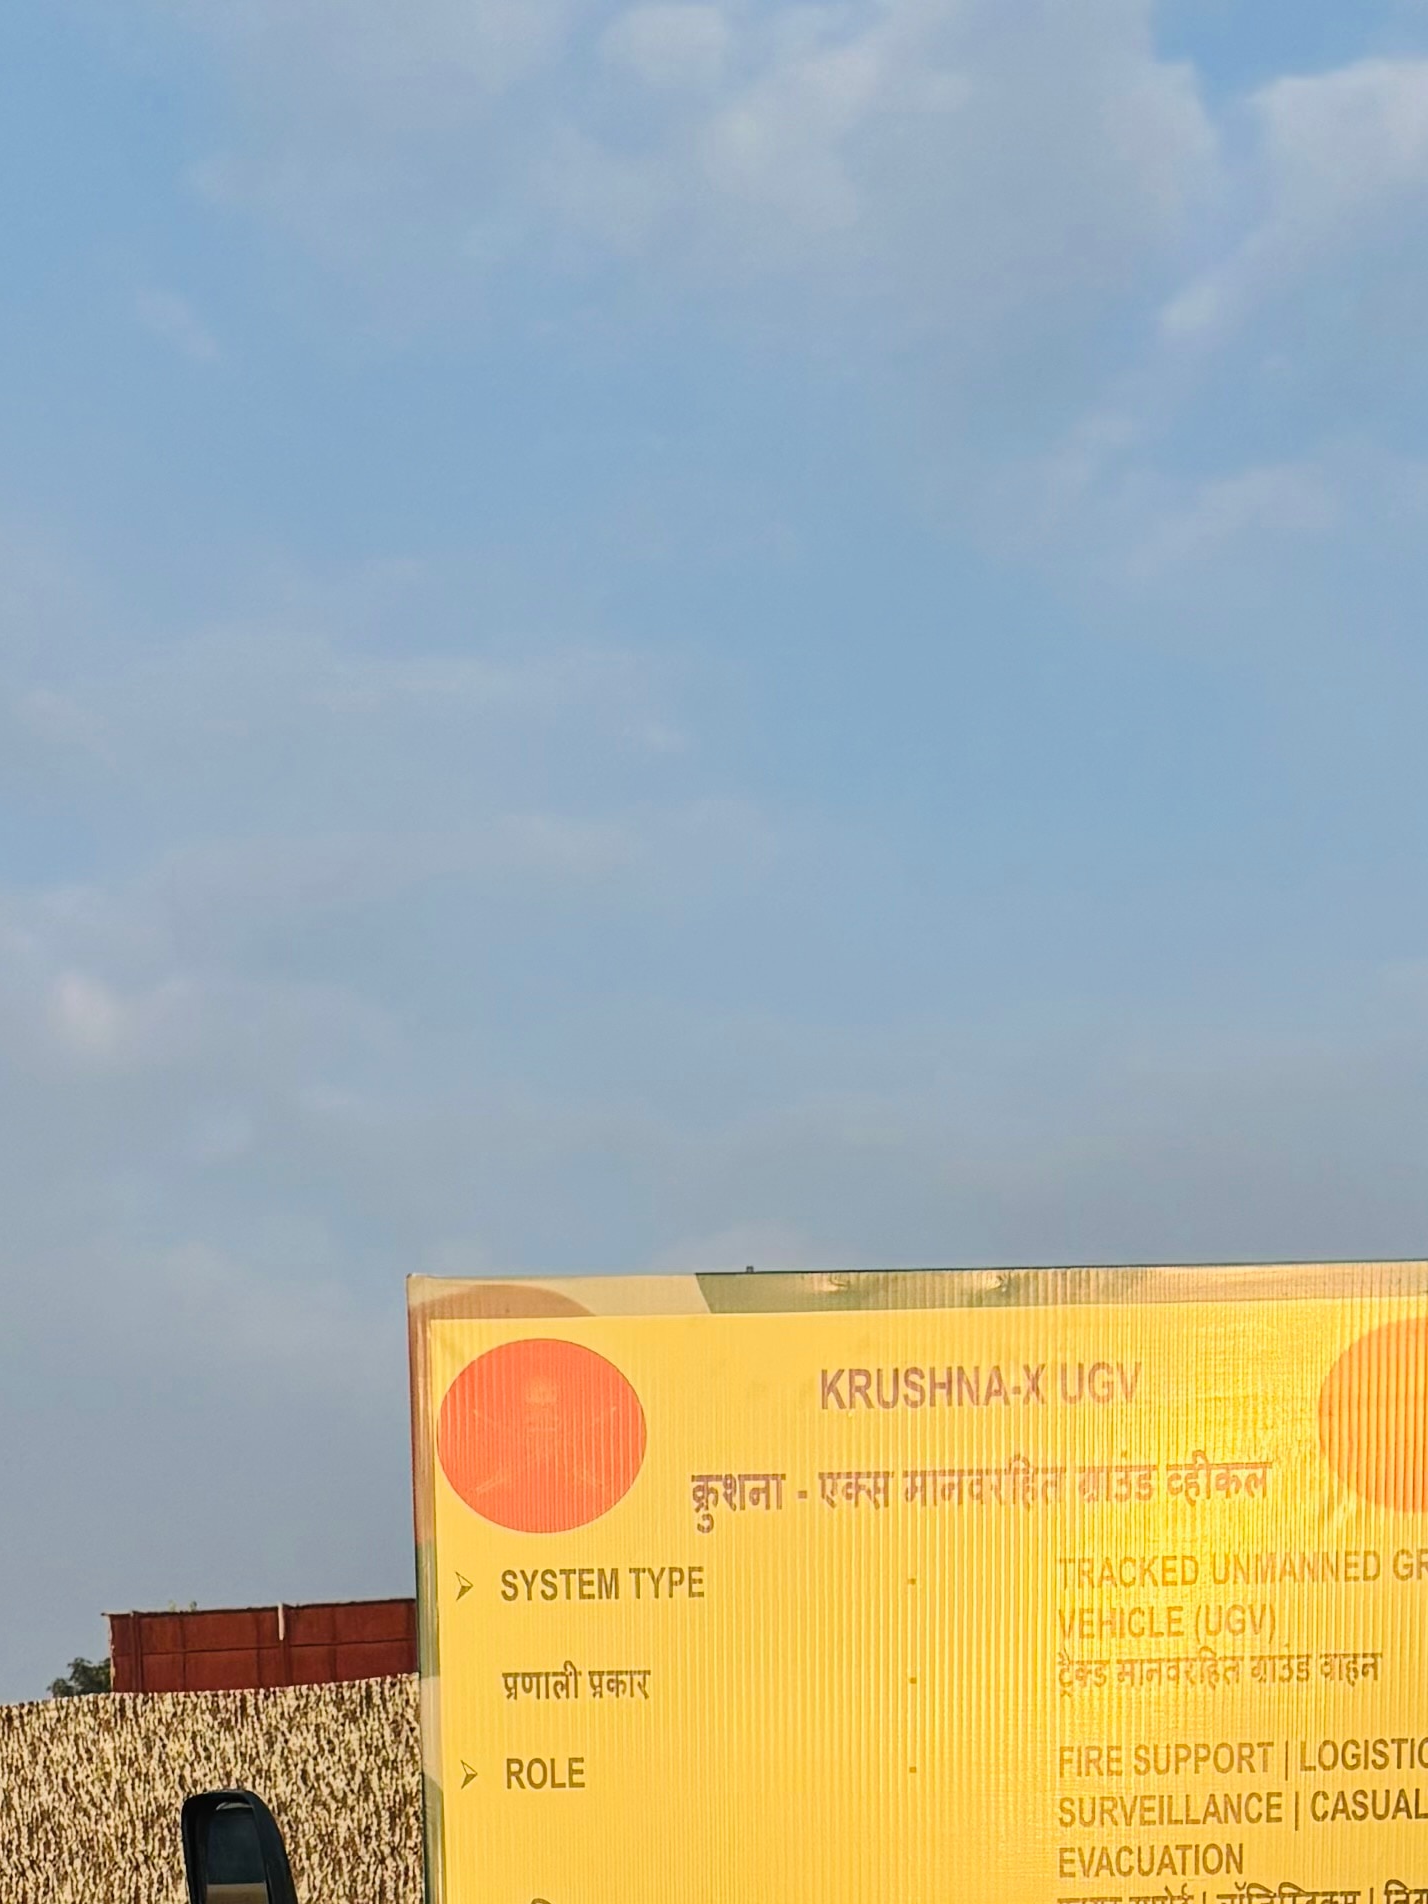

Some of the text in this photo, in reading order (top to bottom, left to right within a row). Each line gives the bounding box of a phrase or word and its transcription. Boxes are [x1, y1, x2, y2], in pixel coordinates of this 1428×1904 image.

[820, 1362, 1142, 1410] KRUSHNA-X UGV
[818, 1470, 892, 1510] एक्स
[903, 1451, 1066, 1511] मानवरहित
[1165, 1450, 1273, 1505] व्हीकल
[501, 1566, 705, 1601] SYSTEM TYPE
[1058, 1553, 1198, 1591] TRACKED
[1212, 1549, 1381, 1586] UNMANNED
[1058, 1602, 1277, 1644] VEHICLE (UGV)
[502, 1660, 651, 1701] प्रणाली प्रकार
[1319, 1652, 1383, 1687] वाहन
[506, 1757, 586, 1789] ROLE
[1059, 1745, 1123, 1778] FIRE
[1132, 1741, 1274, 1776] SUPPORT
[1058, 1791, 1283, 1828] SURVEILLANCE
[1059, 1843, 1244, 1879] EVACUATION
